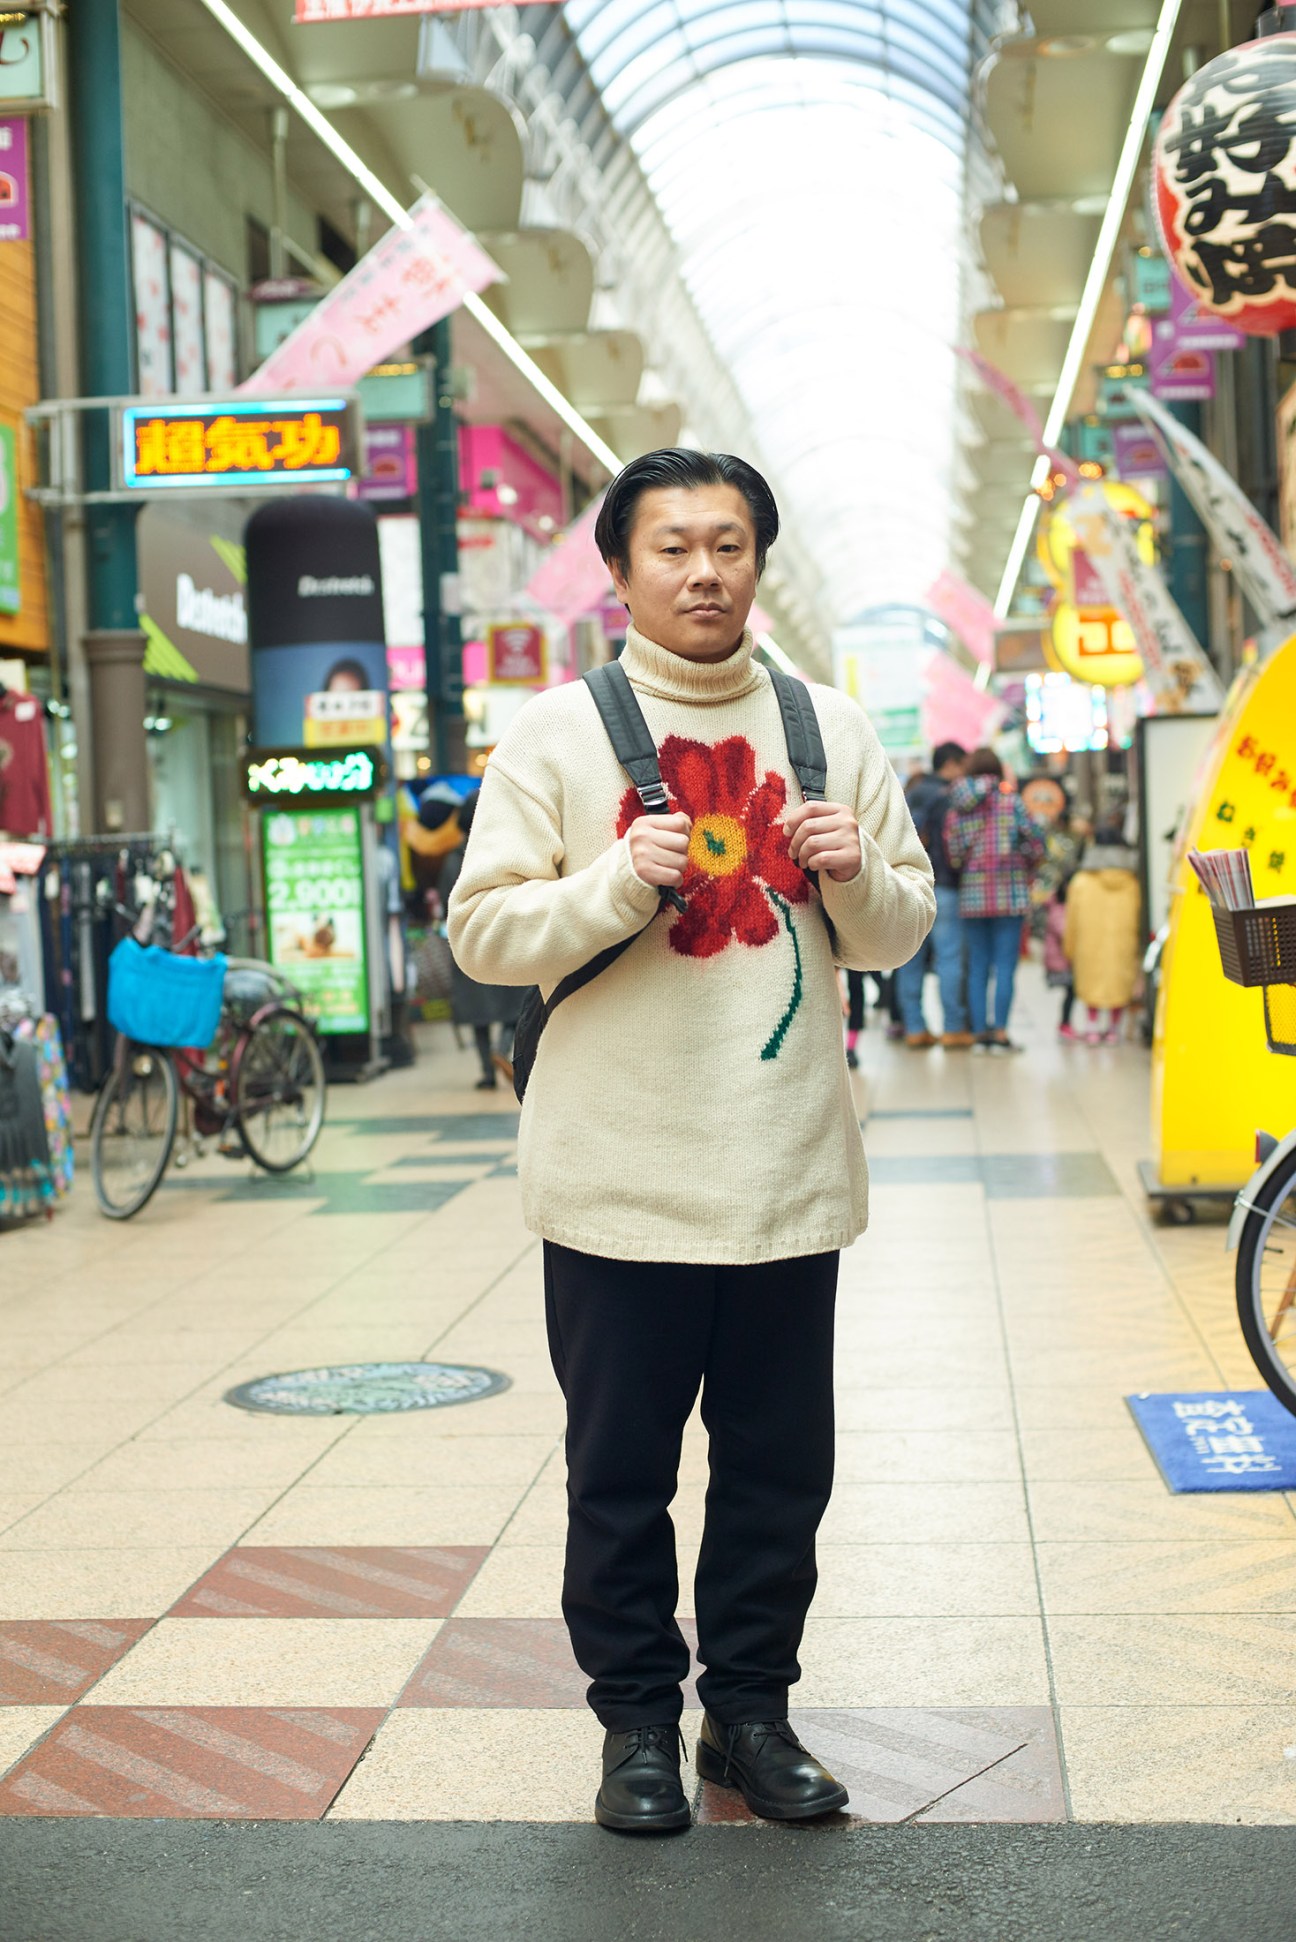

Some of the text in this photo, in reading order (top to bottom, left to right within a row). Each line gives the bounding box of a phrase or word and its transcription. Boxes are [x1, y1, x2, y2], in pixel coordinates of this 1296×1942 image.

[134, 413, 340, 474] 超気功
[1237, 734, 1296, 809] お好み
